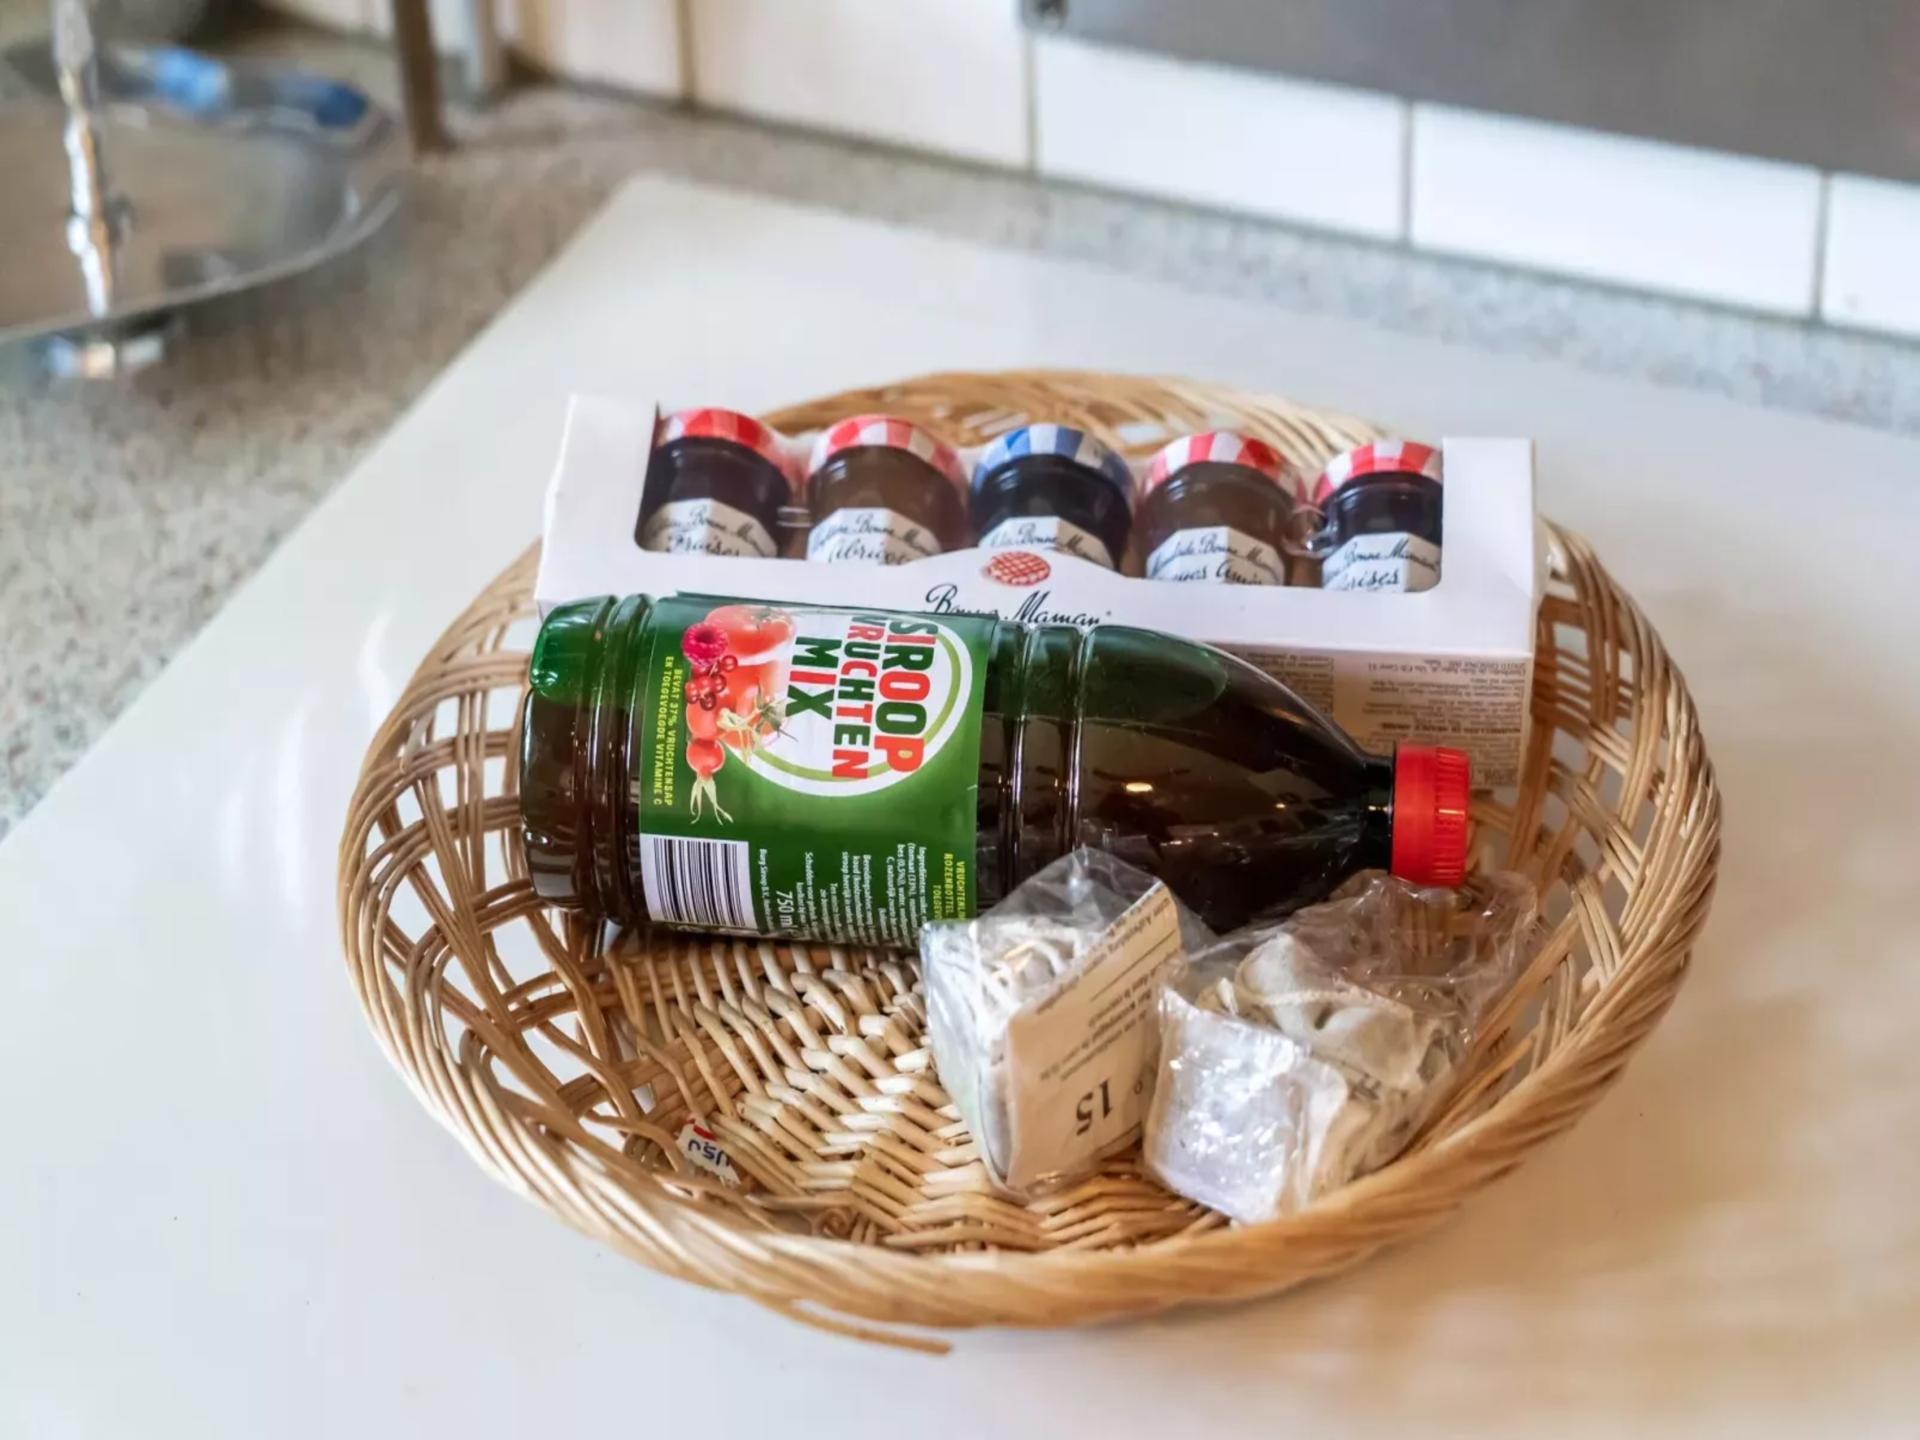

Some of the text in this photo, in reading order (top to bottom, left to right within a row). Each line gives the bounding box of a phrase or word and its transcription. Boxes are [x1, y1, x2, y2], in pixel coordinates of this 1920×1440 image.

[664, 656, 674, 668] EN
[785, 637, 842, 720] MIX
[873, 618, 939, 773] SIROOP
[656, 670, 672, 739] TOEGEVOEGDE
[832, 615, 882, 779] VRUCHTEN
[653, 743, 664, 794] VITAMINE
[664, 668, 683, 806] BEVAT 37% VRUCHTENSAP
[776, 890, 795, 914] 750
[1076, 1079, 1113, 1136] 15
